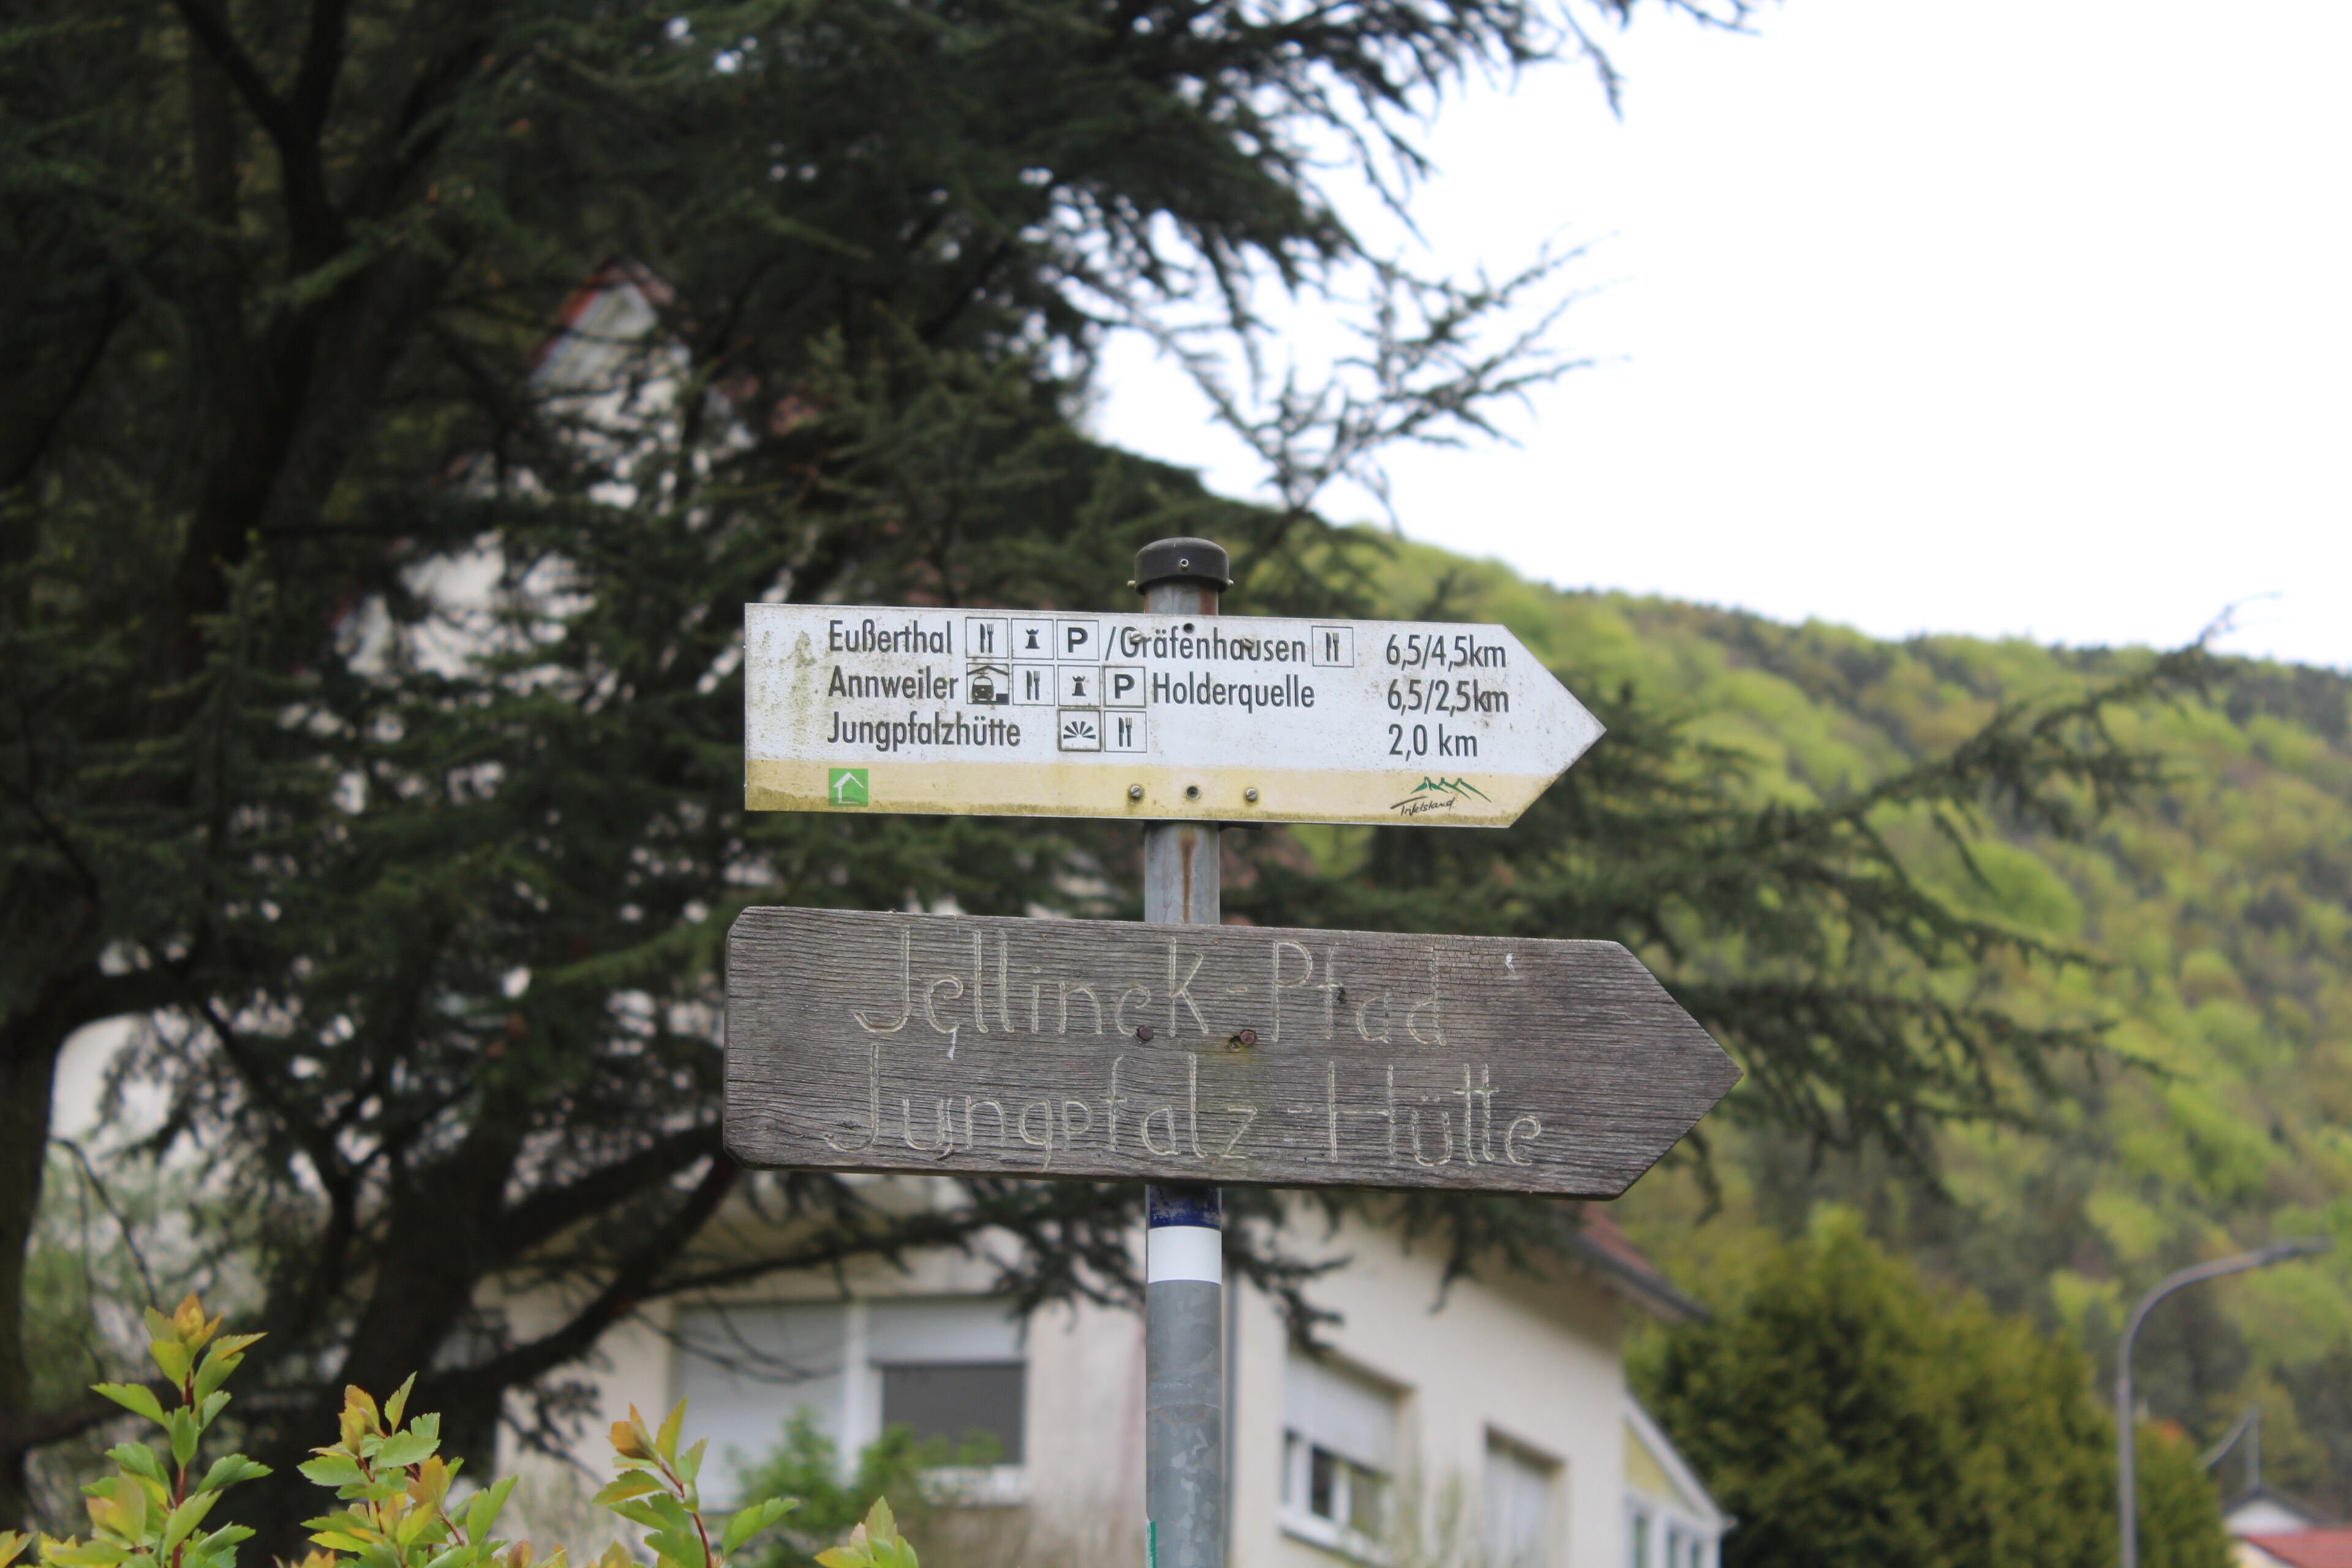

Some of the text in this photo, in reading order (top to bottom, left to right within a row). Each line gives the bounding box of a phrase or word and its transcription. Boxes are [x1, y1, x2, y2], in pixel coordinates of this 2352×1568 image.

[829, 619, 952, 654] Eußerthal
[828, 665, 959, 699] Annweiler
[1153, 672, 1316, 714] Holderquelle
[827, 710, 1478, 760] Jungpfalzhütte 2,0 km
